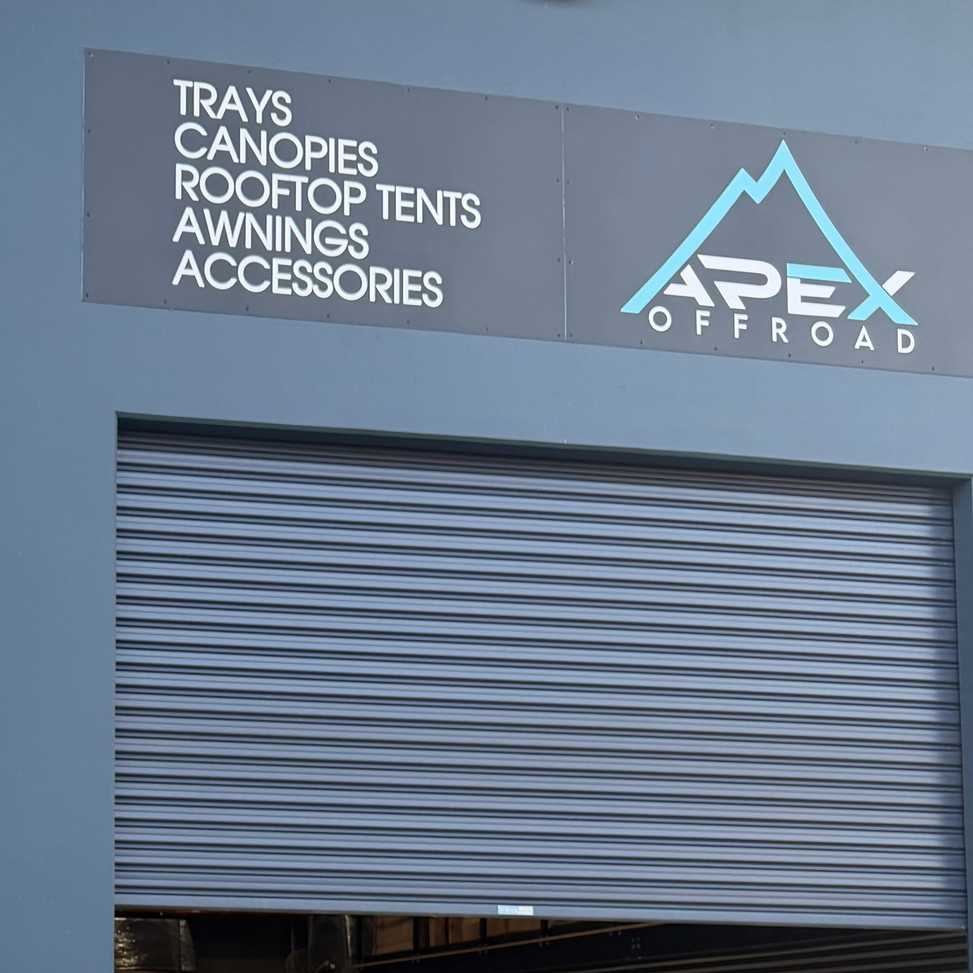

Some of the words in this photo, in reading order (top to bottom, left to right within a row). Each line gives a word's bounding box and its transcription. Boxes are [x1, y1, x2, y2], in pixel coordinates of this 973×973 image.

[172, 78, 293, 127] TRAYS
[174, 121, 379, 178] CANOPIES
[174, 162, 368, 217] ROOFTOP
[375, 182, 482, 230] TENTS
[171, 205, 370, 260] AWNINGS
[171, 248, 444, 308] ACCESSORIES
[662, 253, 918, 326] APEX
[647, 305, 916, 354] OFFROAD
